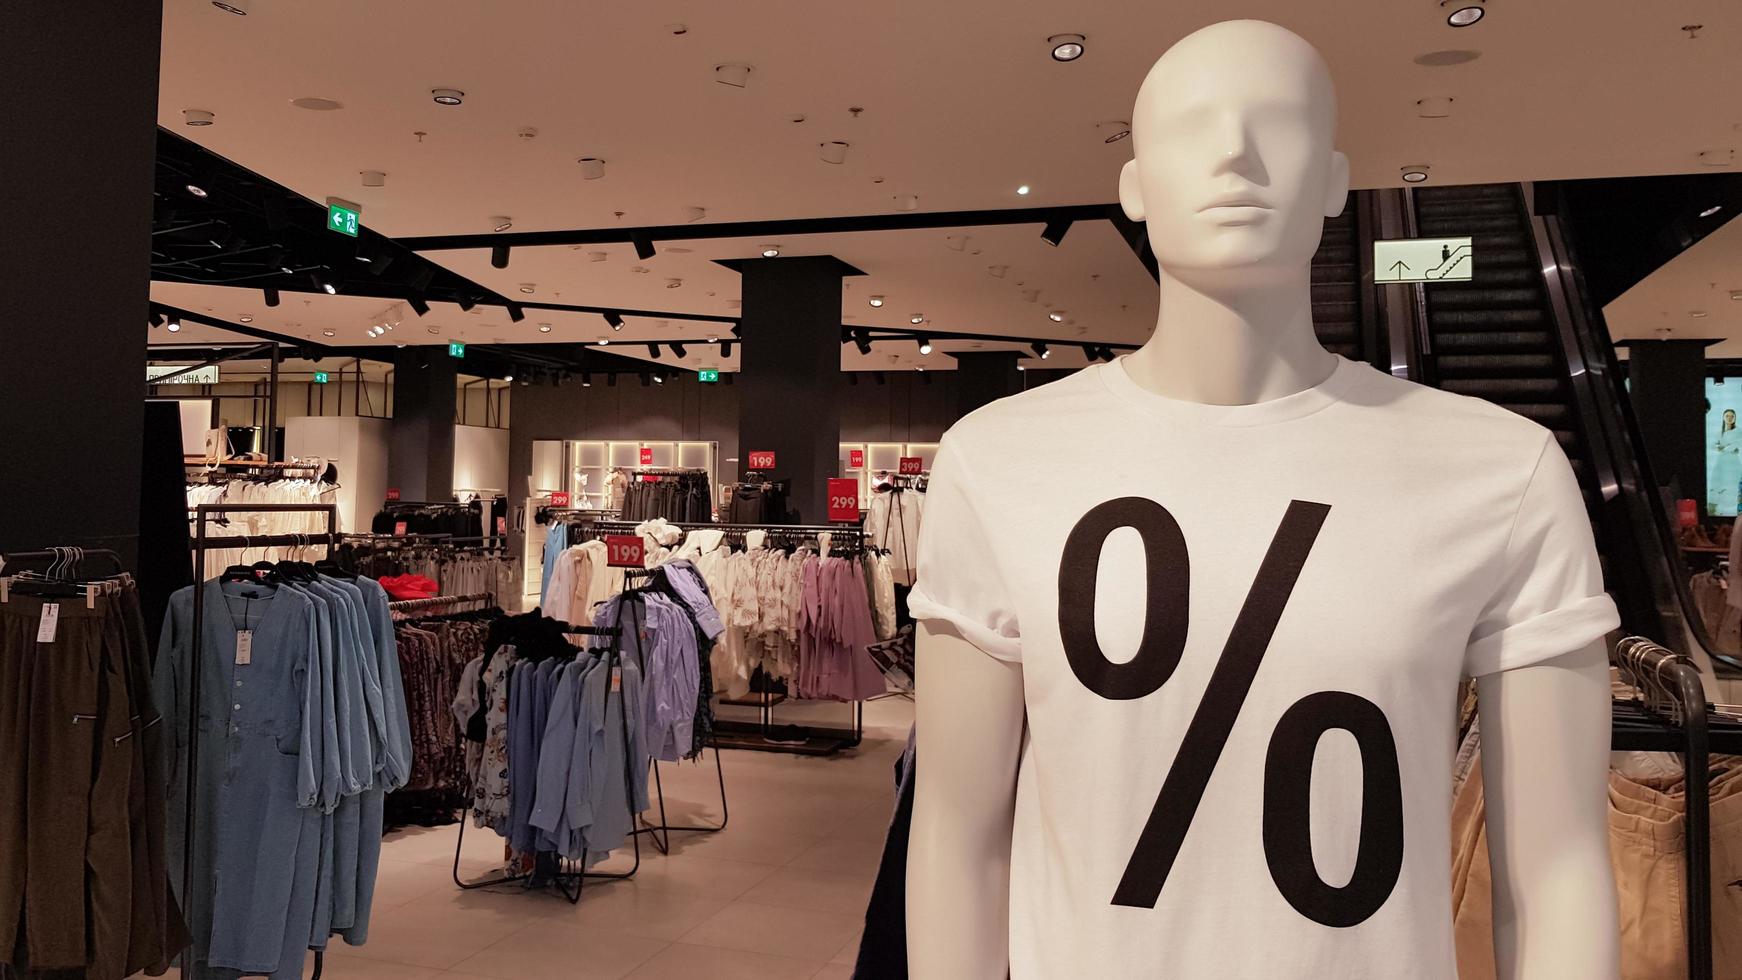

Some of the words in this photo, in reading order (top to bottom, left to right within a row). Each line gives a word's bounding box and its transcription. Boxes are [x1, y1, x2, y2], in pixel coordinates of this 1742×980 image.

[752, 456, 772, 467] 199
[902, 462, 919, 472] 399
[553, 496, 567, 505] 299
[832, 496, 856, 509] 299
[612, 544, 640, 562] 199
[1058, 496, 1404, 928] %
